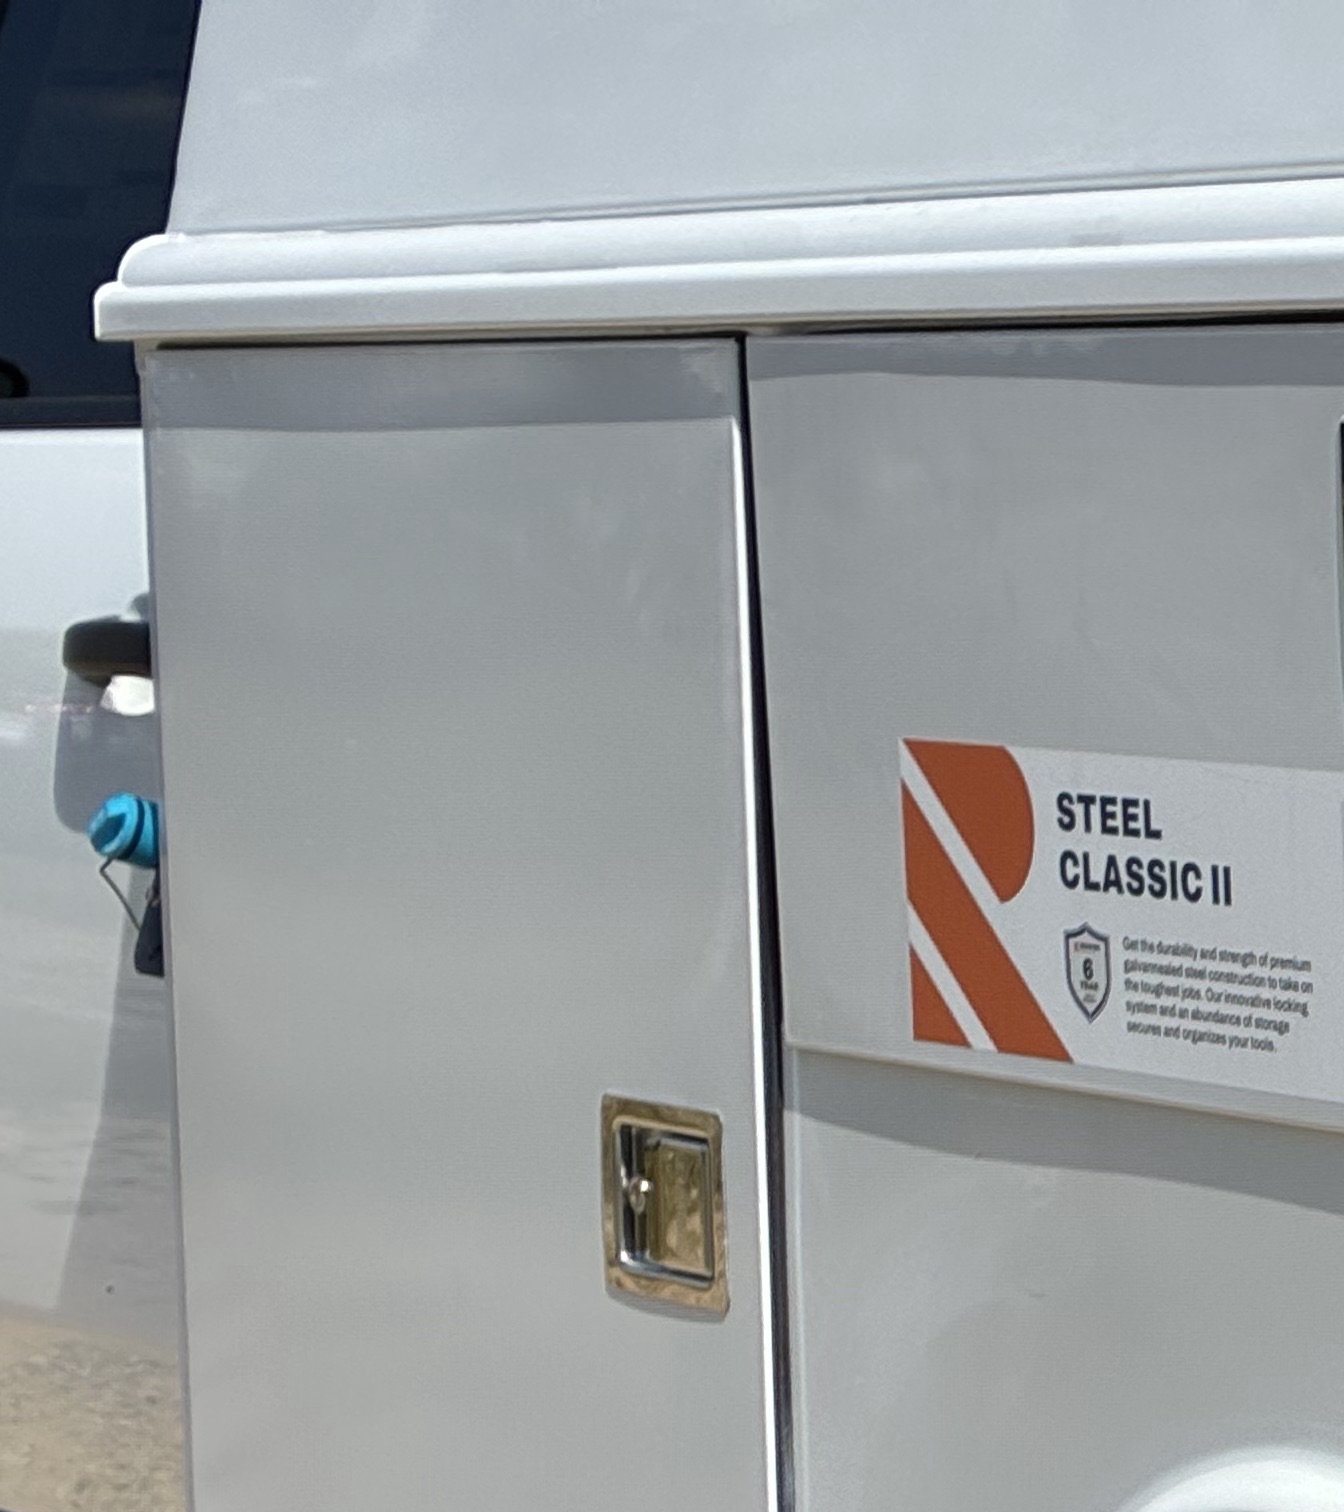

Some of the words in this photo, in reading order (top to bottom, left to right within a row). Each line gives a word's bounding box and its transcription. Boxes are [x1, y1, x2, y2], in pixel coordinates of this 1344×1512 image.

[1056, 791, 1162, 840] STEEL
[1059, 849, 1203, 905] CLASSIC
[1211, 865, 1233, 906] II
[1083, 957, 1094, 980] 6
[1122, 936, 1138, 951] Get
[1140, 938, 1154, 953] the
[1156, 940, 1197, 960] durability
[1200, 946, 1216, 960] and
[1218, 948, 1256, 967] strength
[1259, 952, 1267, 967] of
[1270, 955, 1311, 972] premium
